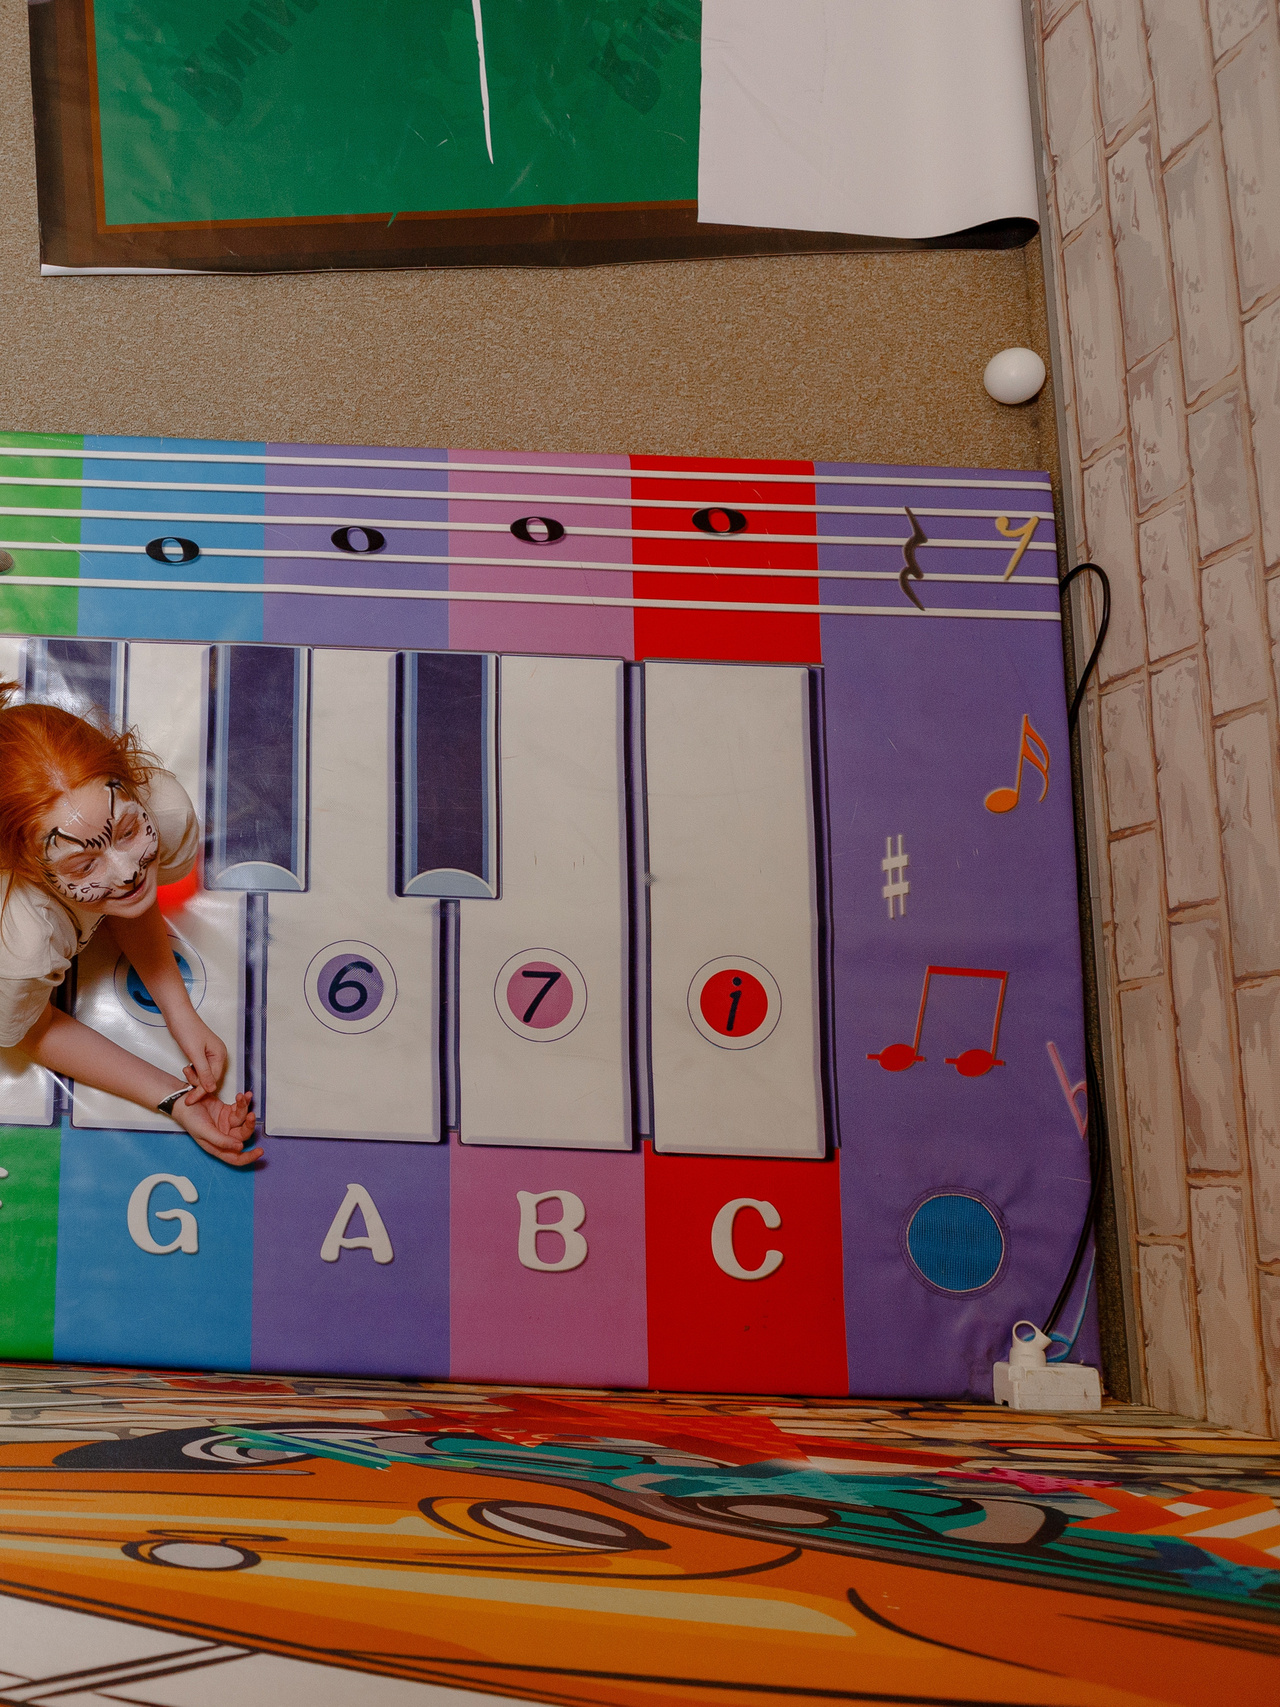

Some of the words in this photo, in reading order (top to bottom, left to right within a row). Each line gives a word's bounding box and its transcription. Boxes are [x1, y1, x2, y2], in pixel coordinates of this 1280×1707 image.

[327, 961, 374, 1013] 6
[521, 970, 561, 1024] 7
[127, 1173, 199, 1254] G
[320, 1182, 394, 1264] A
[516, 1190, 588, 1272] B
[711, 1198, 784, 1281] C
